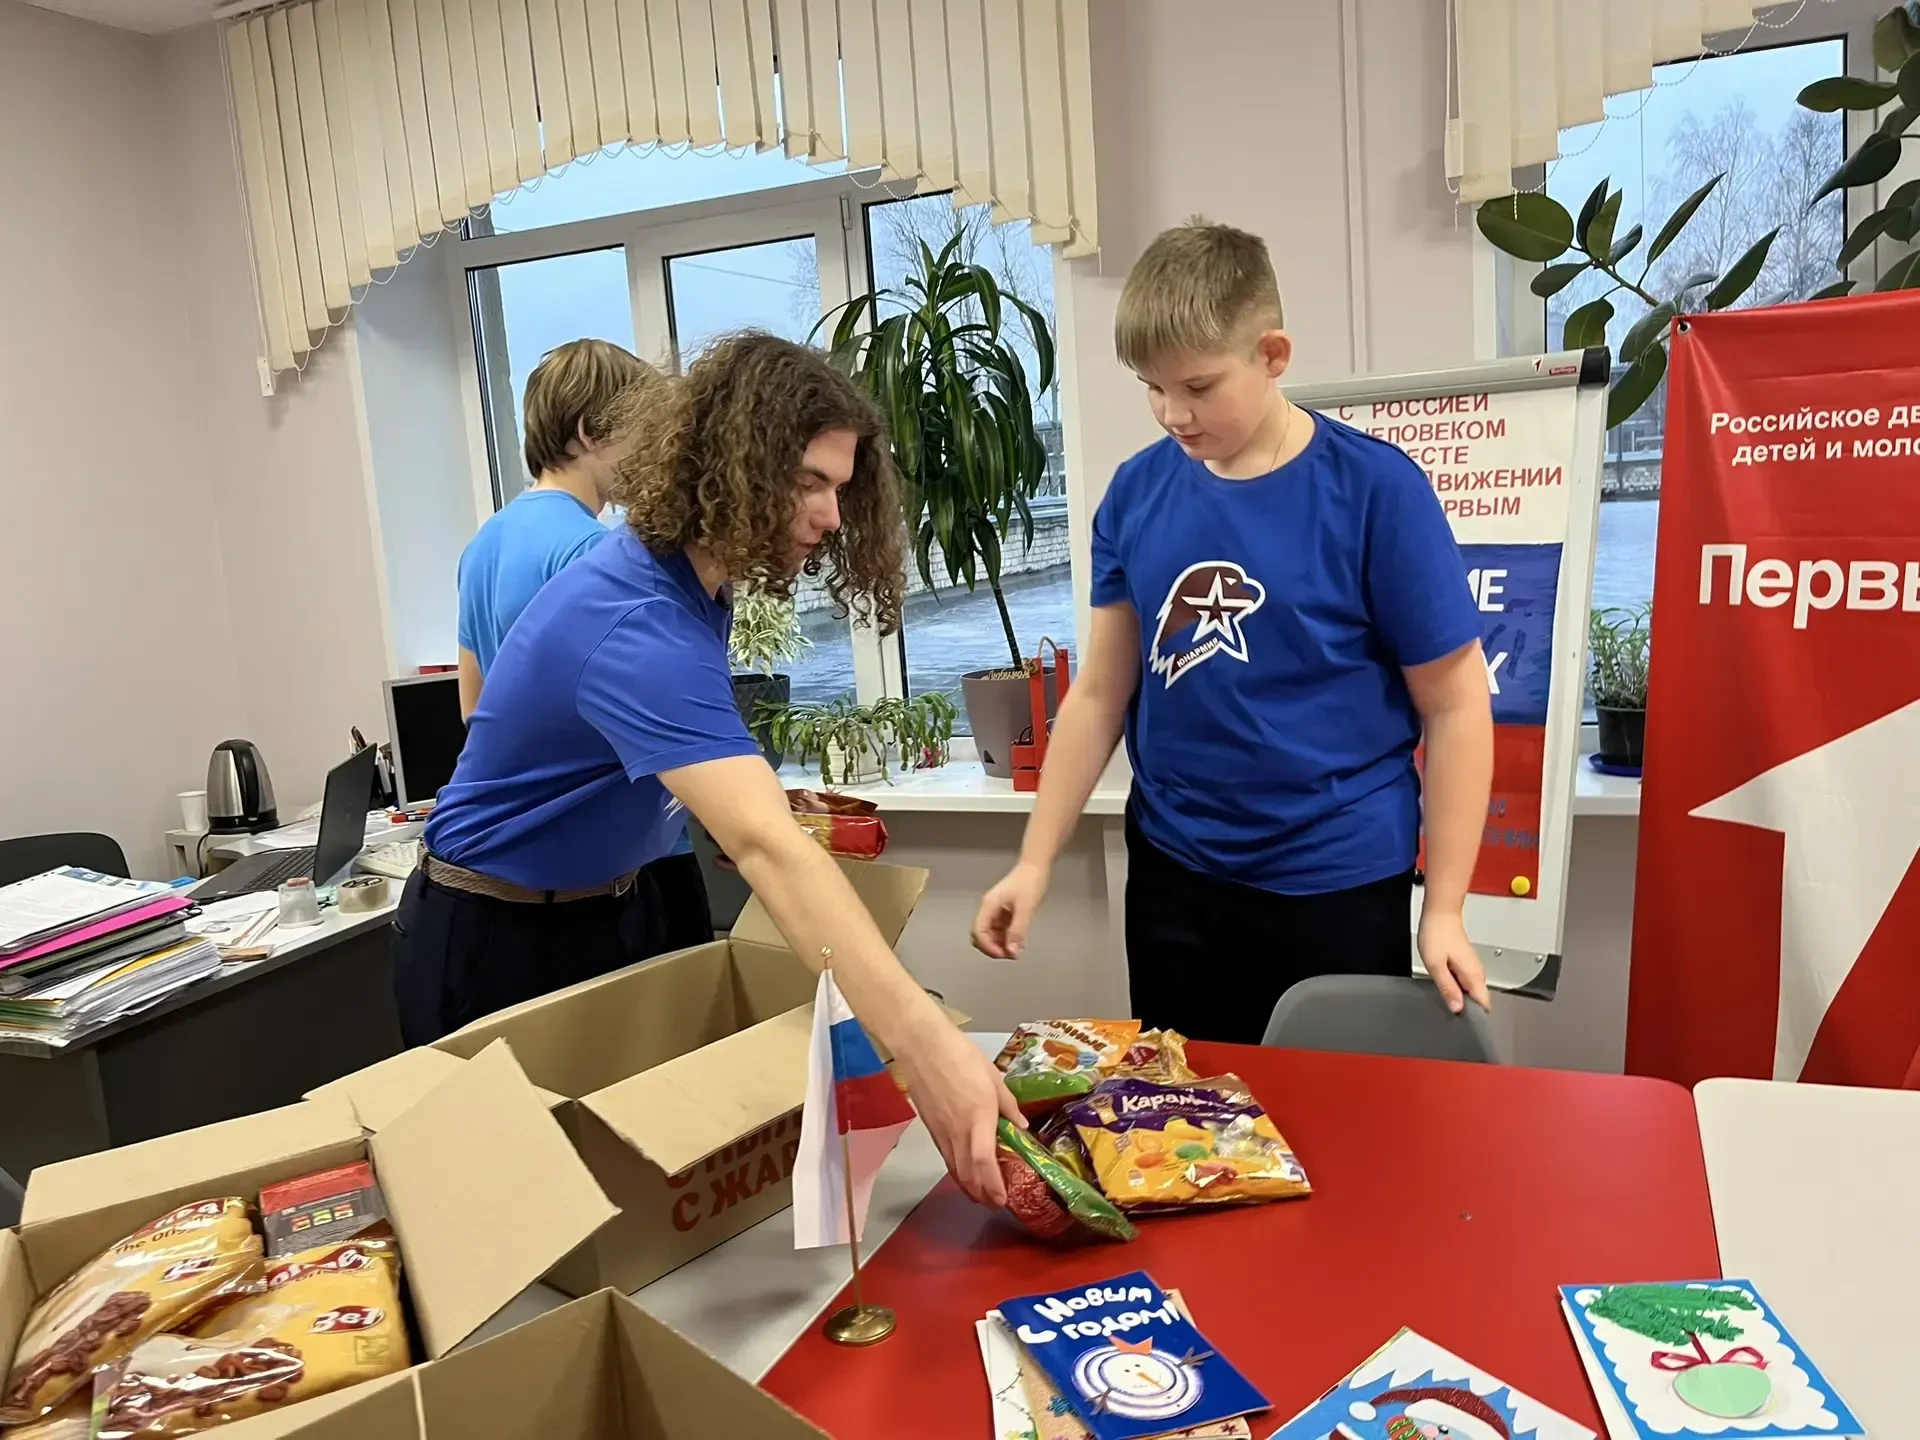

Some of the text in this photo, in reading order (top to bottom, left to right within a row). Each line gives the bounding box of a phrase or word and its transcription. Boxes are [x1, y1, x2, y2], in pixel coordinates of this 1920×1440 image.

[1710, 406, 1880, 435] Российское
[1731, 437, 1816, 467] детей
[1825, 440, 1843, 460] и
[1442, 496, 1522, 519] РВЫМ
[1176, 637, 1220, 668] ЮНАРМИЯ
[671, 1191, 701, 1233] С
[1032, 1286, 1153, 1324] Новым
